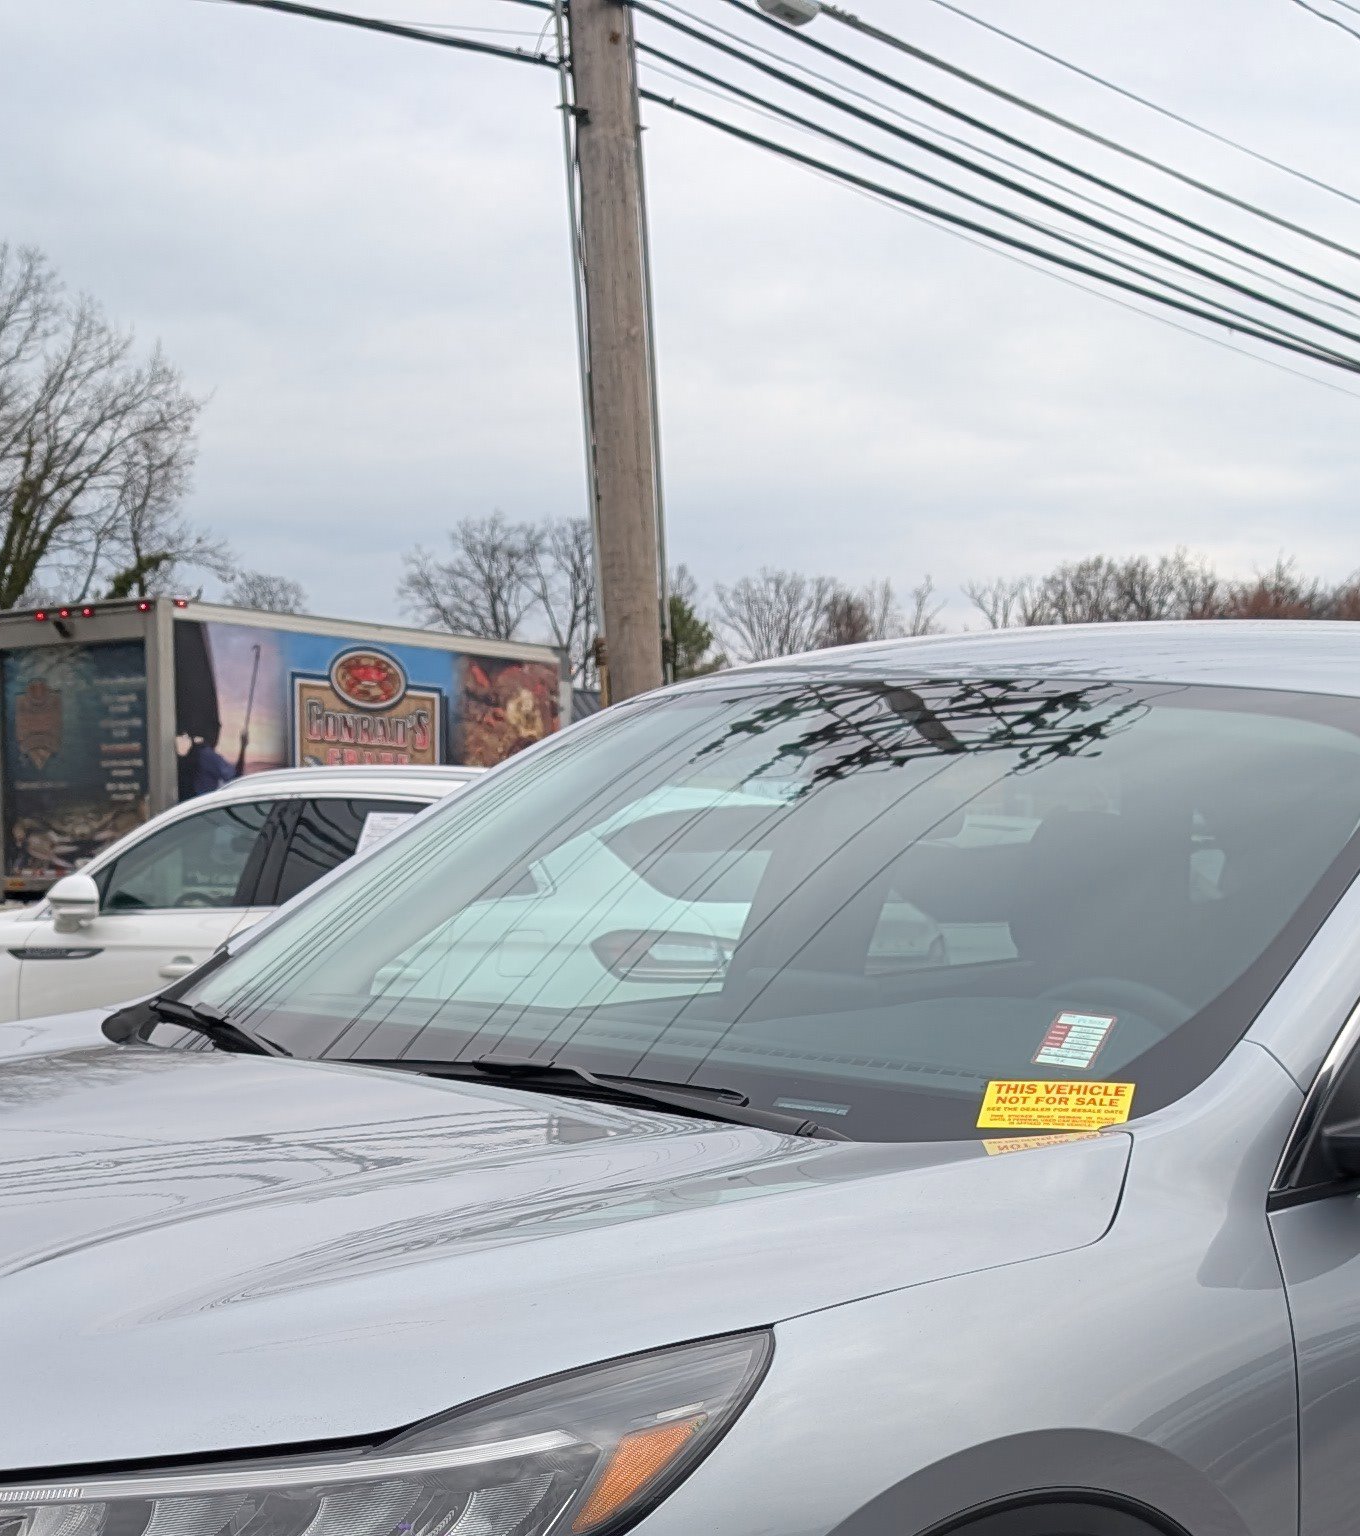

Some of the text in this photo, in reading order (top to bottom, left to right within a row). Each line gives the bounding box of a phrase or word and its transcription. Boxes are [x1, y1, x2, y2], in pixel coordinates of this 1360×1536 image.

[306, 698, 430, 750] CONRAD'S
[995, 1084, 1128, 1097] THIS VEHICLE
[995, 1096, 1120, 1107] NOT FOR SALE
